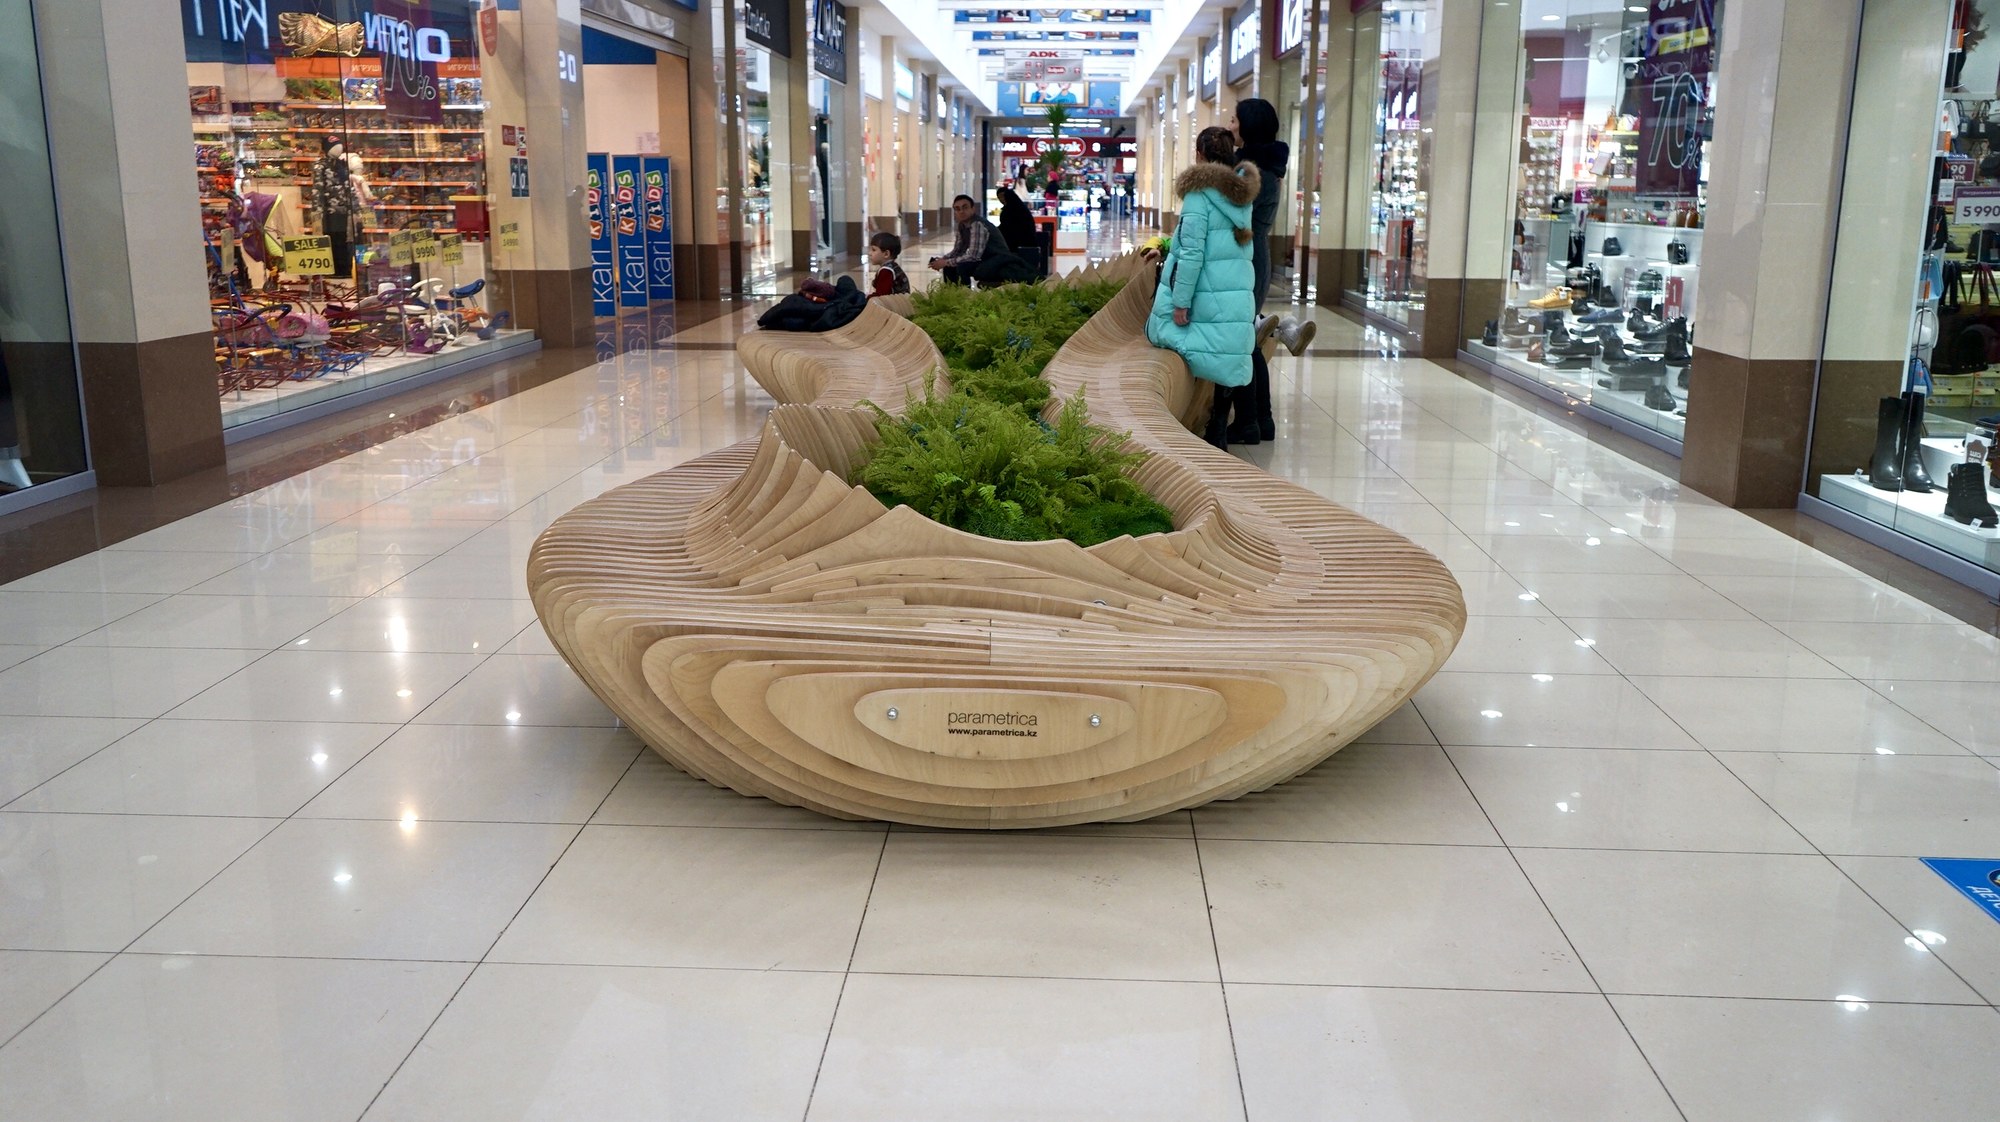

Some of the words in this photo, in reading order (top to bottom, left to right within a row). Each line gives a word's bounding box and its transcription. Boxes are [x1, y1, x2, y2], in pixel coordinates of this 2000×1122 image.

[619, 174, 635, 232] KIDS
[648, 174, 662, 229] KIDS
[294, 239, 318, 250] SALE
[416, 246, 436, 259] 9990
[299, 258, 330, 269] 4790
[619, 245, 645, 294] kari
[648, 241, 672, 287] kari
[948, 711, 1038, 726] parametrica
[948, 728, 1038, 737] www.parametrica.kz
